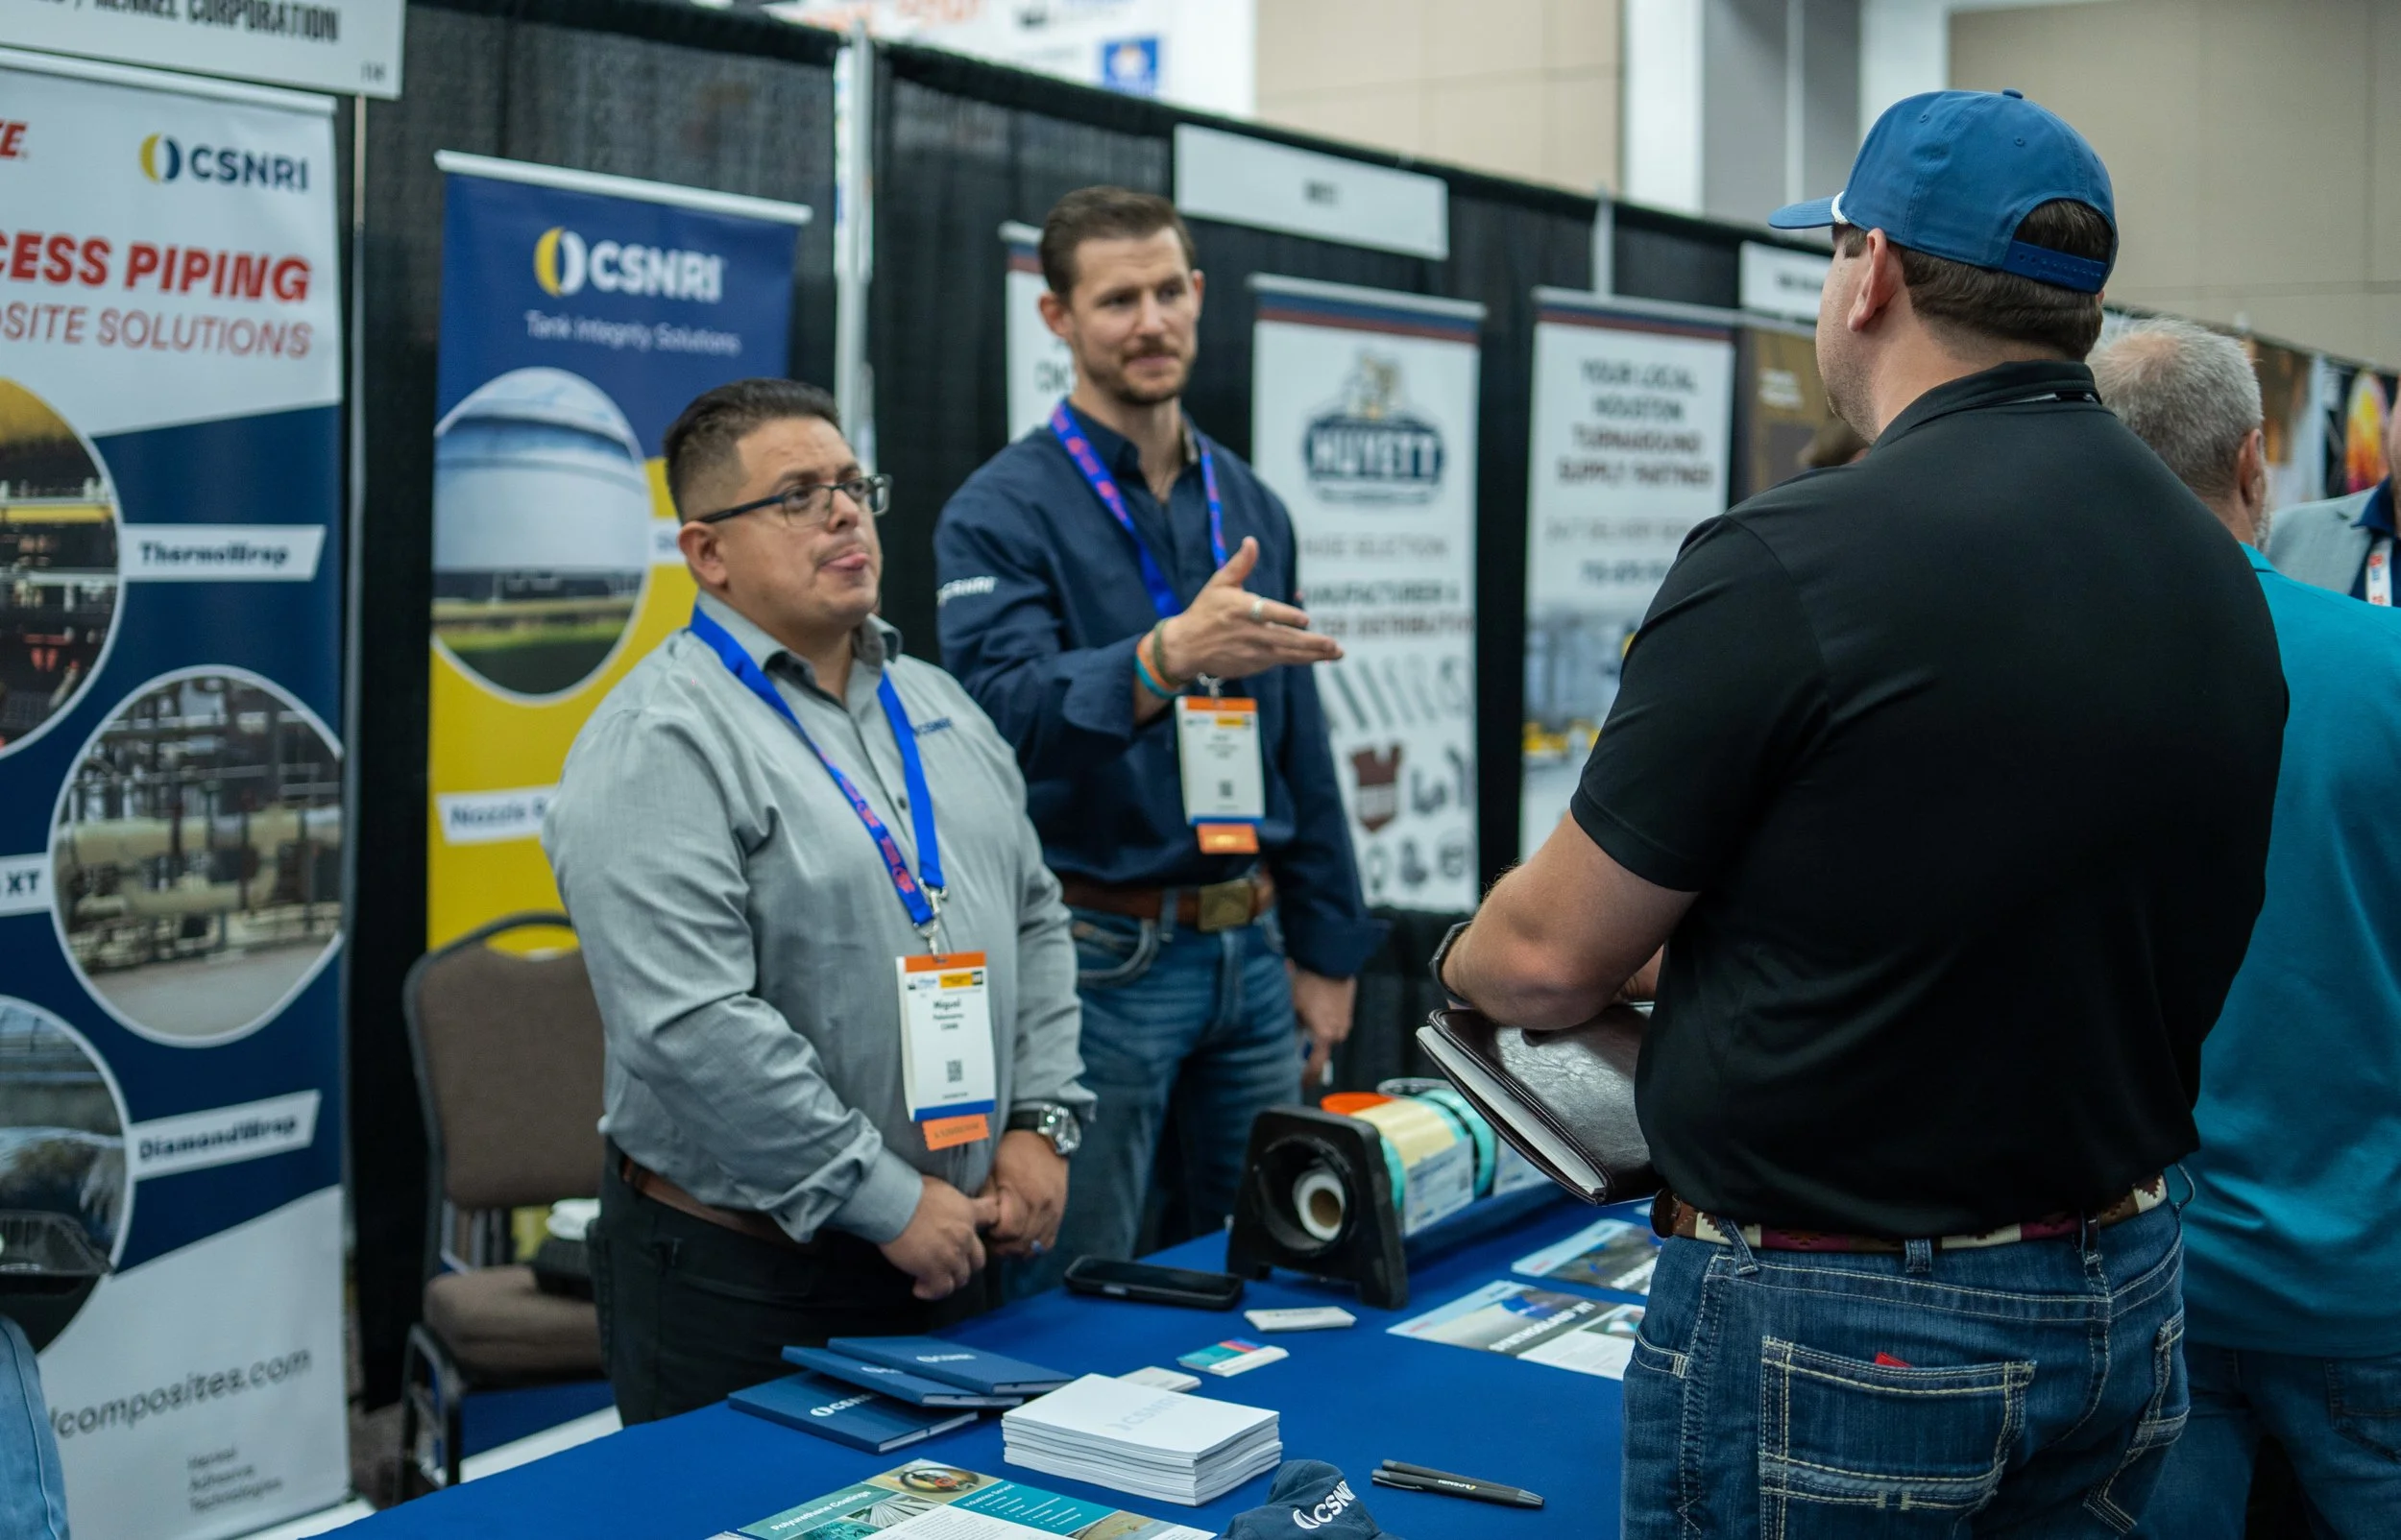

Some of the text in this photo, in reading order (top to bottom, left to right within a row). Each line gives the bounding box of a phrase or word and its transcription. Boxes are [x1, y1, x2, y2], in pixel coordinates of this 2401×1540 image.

[191, 145, 310, 191] CSNRI
[0, 230, 311, 303] ESS PIPING
[590, 240, 724, 304] CSNRI
[0, 302, 313, 359] SITE SOLUTIONS
[7, 869, 40, 895] XT
